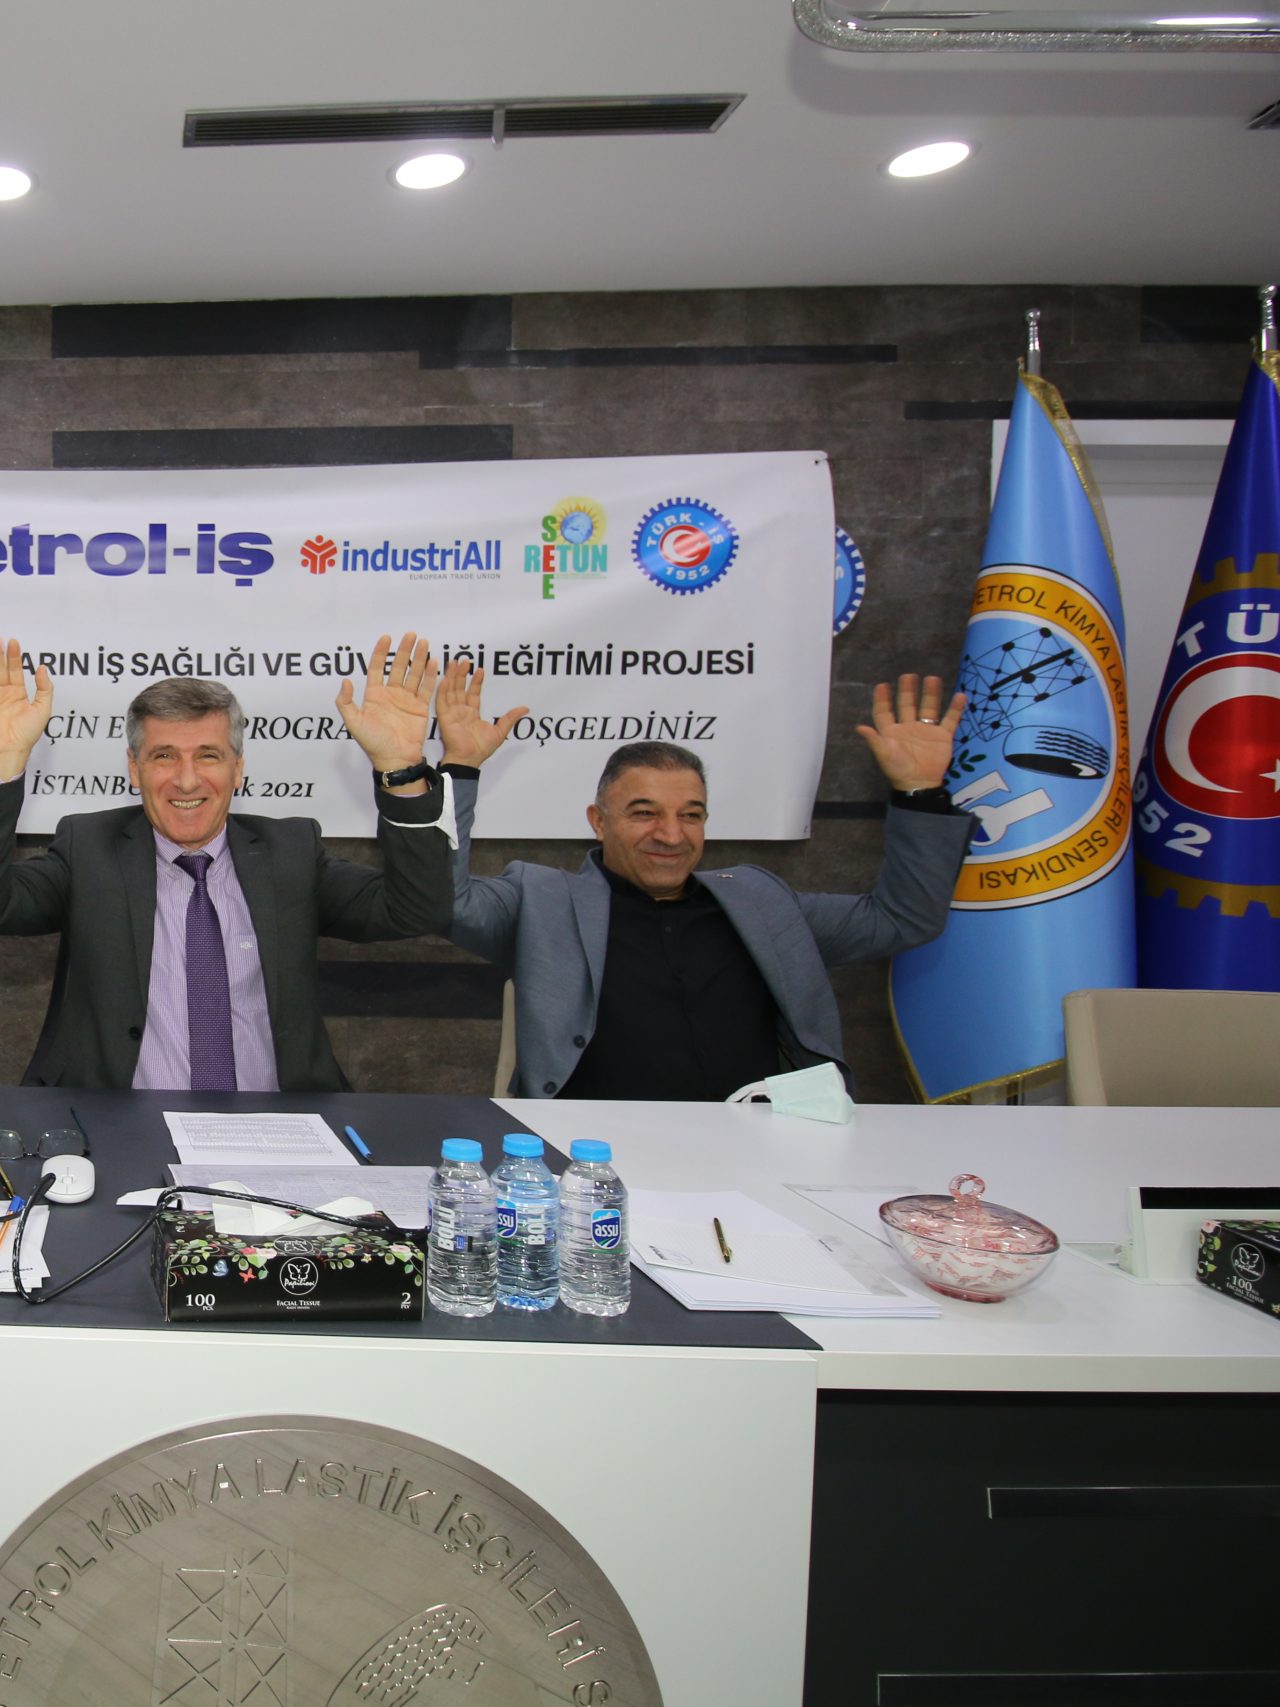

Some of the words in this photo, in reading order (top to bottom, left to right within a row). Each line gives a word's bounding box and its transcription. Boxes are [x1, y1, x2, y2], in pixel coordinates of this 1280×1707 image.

[646, 512, 692, 548] TÜRK
[342, 540, 501, 572] industriAll
[665, 564, 710, 581] 1952
[975, 584, 1048, 610] ETROL
[1055, 600, 1110, 661] KİMYA
[98, 646, 124, 683] İŞ
[131, 646, 255, 676] SAĞLIĞI
[262, 653, 302, 676] VE
[493, 643, 613, 675] EĞİTİMİ
[621, 642, 754, 675] PROJESİ
[44, 709, 100, 746] ÇİN
[493, 710, 717, 747] OŞGELDİNİZ
[31, 769, 140, 796] İSTANBU
[261, 782, 316, 798] 2021
[978, 829, 1110, 889] SENDİKASI
[437, 1205, 456, 1251] BOLU
[498, 1212, 514, 1228] ssu
[401, 1292, 412, 1304] 2
[1231, 1275, 1253, 1292] 100
[185, 1294, 216, 1307] 100
[86, 1462, 244, 1552] KİMYA
[255, 1458, 436, 1525] LASTİK
[433, 1493, 606, 1670] İŞÇİLERİ
